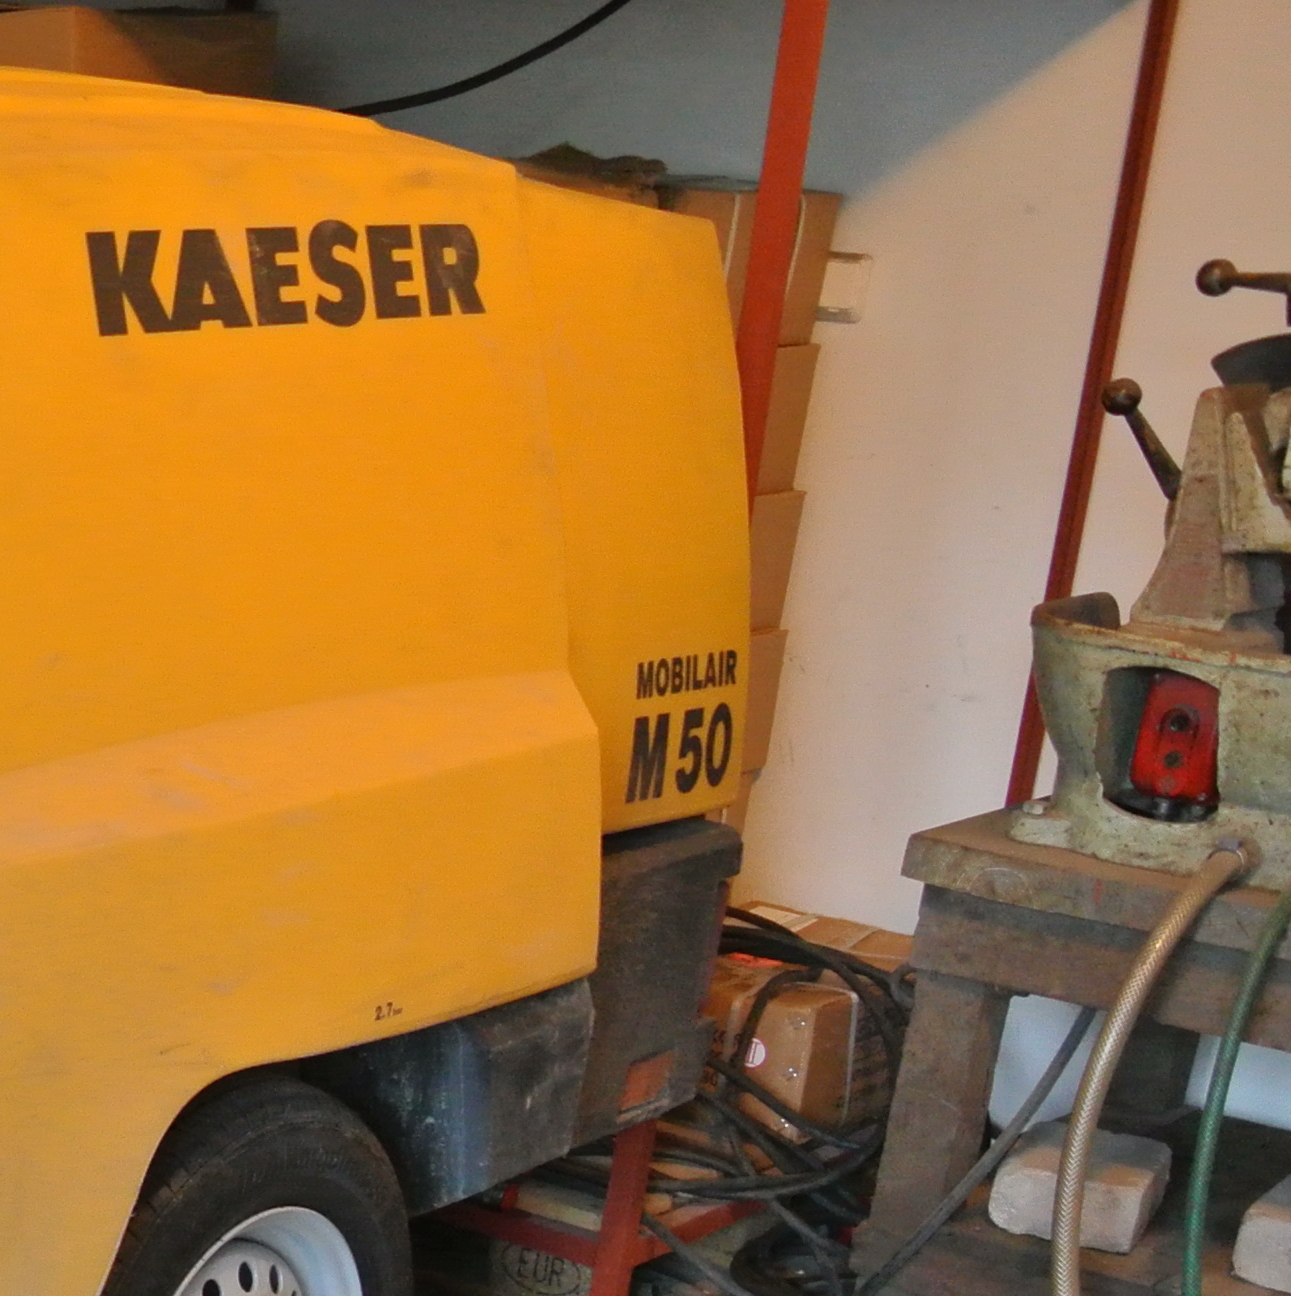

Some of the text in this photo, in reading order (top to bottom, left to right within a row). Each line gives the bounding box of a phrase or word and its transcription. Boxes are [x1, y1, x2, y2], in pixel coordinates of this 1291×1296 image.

[86, 219, 486, 336] KAESER
[636, 650, 737, 700] MOBILAIR
[625, 702, 733, 804] M 50
[518, 1247, 564, 1288] EUR
